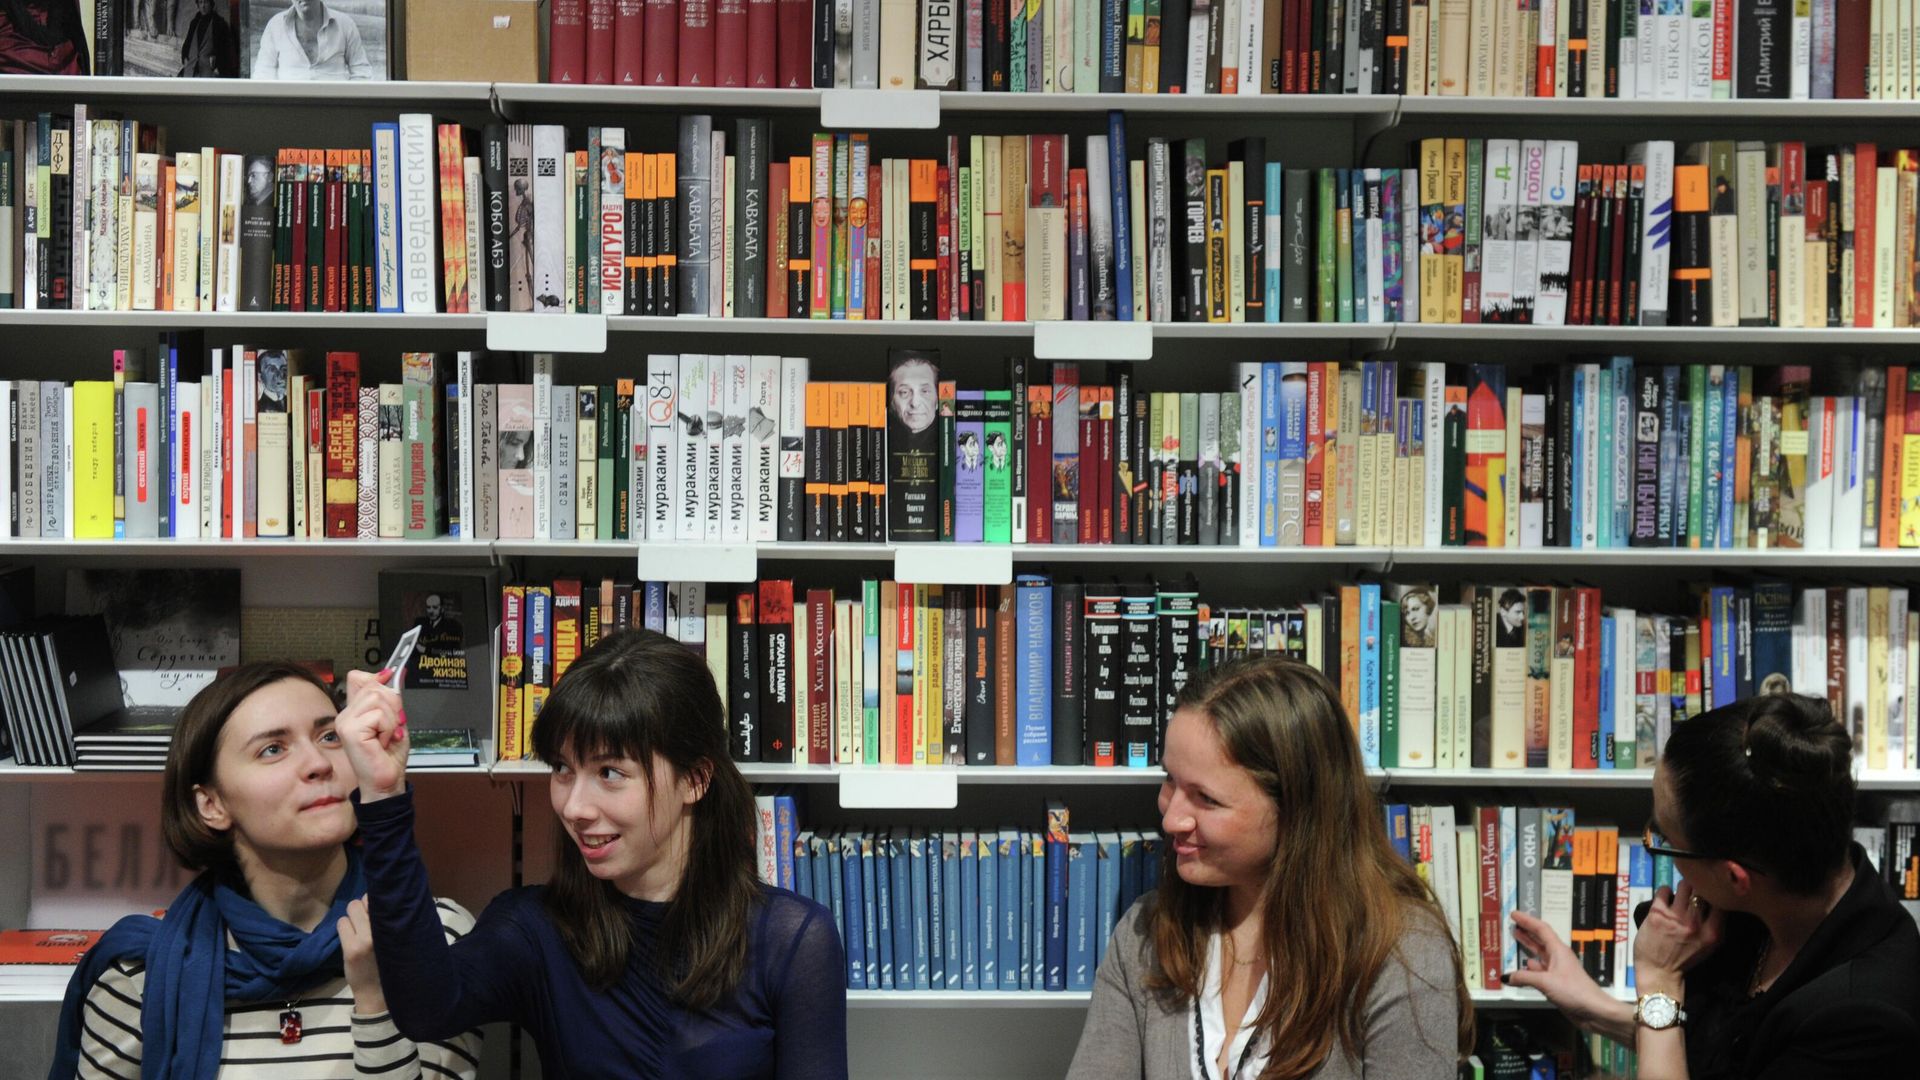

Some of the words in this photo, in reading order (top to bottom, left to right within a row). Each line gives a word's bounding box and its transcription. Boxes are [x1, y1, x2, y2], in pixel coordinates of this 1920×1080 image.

[1478, 25, 1490, 81] БУЛГАКОВ
[1642, 19, 1652, 64] БЫКОВ
[1667, 19, 1680, 80] БЫКОВ
[1698, 22, 1711, 87] БЫКОВ
[1714, 27, 1724, 76] СОВЕТСКАЯ
[1756, 18, 1774, 87] Дмитрий
[816, 145, 828, 198] МИСИМА
[836, 144, 847, 198] МИСИМА
[854, 145, 865, 198] МИСИМА
[1827, 155, 1839, 181] 2008
[1355, 195, 1364, 219] Реки
[1370, 186, 1379, 219] РУБАШКА
[1468, 164, 1479, 216] ГУБЕРМАН
[402, 124, 430, 303] а.введенский
[491, 191, 503, 234] КОБО
[689, 185, 701, 257] КАВАБАТА
[711, 197, 722, 261] КАВАБАТА
[744, 189, 758, 261] КАВАБАТА
[1187, 200, 1204, 244] ГОРЧЕВ
[1468, 217, 1479, 240] Игорь
[121, 224, 129, 292] АХМАДУЛИНА
[144, 224, 152, 285] АХМАДУЛИНА
[180, 245, 188, 282] МАЦУО
[202, 237, 211, 275] БЕРГГОЛЬЦ
[468, 219, 478, 280] ОБЕЩАНИЕ
[491, 239, 504, 268] АБЭ
[603, 212, 623, 291] ИСИГУРО
[896, 240, 906, 270] САЙКАКУ
[1118, 239, 1126, 270] Фридрих
[1135, 255, 1143, 287] ГОРЬКИЙ
[275, 263, 283, 304] БРОДСКИЙ
[283, 264, 291, 304] БРОДСКИЙ
[294, 264, 302, 304] БРОДСКИЙ
[311, 265, 319, 305] БРОДСКИЙ
[327, 266, 335, 306] БРОДСКИЙ
[567, 271, 575, 289] КОБО
[883, 250, 892, 295] КЭНДЗАБУРО
[897, 272, 905, 295] ИХАРА
[1097, 255, 1108, 300] Фридрих
[28, 392, 37, 430] Кенжеев
[649, 370, 676, 432] 1Q84
[1015, 383, 1023, 405] Ангел
[1247, 384, 1256, 432] АЛЕКСАНДР
[1642, 377, 1653, 408] Кетро
[328, 420, 342, 459] СЕРГЕЙ
[342, 414, 356, 473] НЕЛЬДИХЕН
[1015, 414, 1023, 440] Старик
[1119, 416, 1128, 461] Иличевский
[138, 450, 146, 488] евгений
[203, 450, 211, 491] ЛЕРМОНТОВ
[409, 443, 426, 496] Окуджава
[559, 433, 568, 466] КНИГ
[1246, 432, 1257, 483] ИЛИЧЕВСКИЙ
[1532, 434, 1542, 492] ЧЕЛОВЕК
[1638, 444, 1655, 481] КНИГА
[24, 437, 33, 514] СООБЩЕНИЕ
[295, 461, 303, 495] НЕКРАСОВ
[393, 457, 402, 510] ОКУДЖАВА
[559, 473, 568, 506] СЕМЬ
[635, 466, 644, 519] мураками
[655, 445, 668, 521] мураками
[686, 443, 699, 517] мураками
[708, 445, 721, 520] мураками
[731, 445, 743, 520] мураками
[759, 446, 772, 522] мураками
[1165, 463, 1176, 529] ГУШ-МУЛЛА
[409, 499, 424, 530] Булат
[1246, 485, 1256, 528] МАТЕМАТИК
[1281, 473, 1299, 536] ПЕРС
[1636, 484, 1656, 538] ОБМАНОВ
[1659, 472, 1671, 538] МАГИЧКИ
[1678, 484, 1687, 535] МАГИЧКИ
[507, 595, 518, 618] ТИГР
[533, 596, 544, 633] УБИЙСТВА
[650, 586, 658, 615] АМОС
[687, 586, 697, 636] Стамбул
[1029, 592, 1044, 648] НАБОКОВ
[506, 619, 518, 653] БЕЛЫЙ
[776, 633, 786, 667] ОРХАН
[814, 603, 824, 657] ХОССЕЙНИ
[1001, 620, 1010, 654] Вылазка
[419, 655, 465, 670] Двойная
[533, 647, 543, 684] УБИЙСТВА
[945, 638, 954, 690] Мандельштам
[953, 638, 962, 674] марка
[1366, 659, 1375, 677] Как
[776, 669, 786, 703] ПАМУК
[797, 690, 805, 713] ПАМУК
[841, 680, 849, 722] МОРДОВЦЕВ
[945, 691, 954, 709] Осип
[952, 676, 962, 733] Египетская
[1000, 663, 1010, 737] действительность
[1029, 652, 1044, 720] ВЛАДИМИР
[1365, 678, 1375, 717] делать
[503, 711, 517, 752] АРАВИНД
[797, 713, 805, 737] ОРХАН
[813, 704, 821, 747] БЕГУЩИЙ
[1534, 685, 1544, 744] АПТЕКАРЬ
[821, 737, 828, 749] ЗА
[1364, 719, 1374, 754] погоду
[1524, 823, 1536, 867] ОКНА
[932, 855, 941, 894] ЛИСТОПАДА
[1615, 873, 1629, 943] РУБИНА
[933, 922, 942, 958] КИПАРИСЫ
